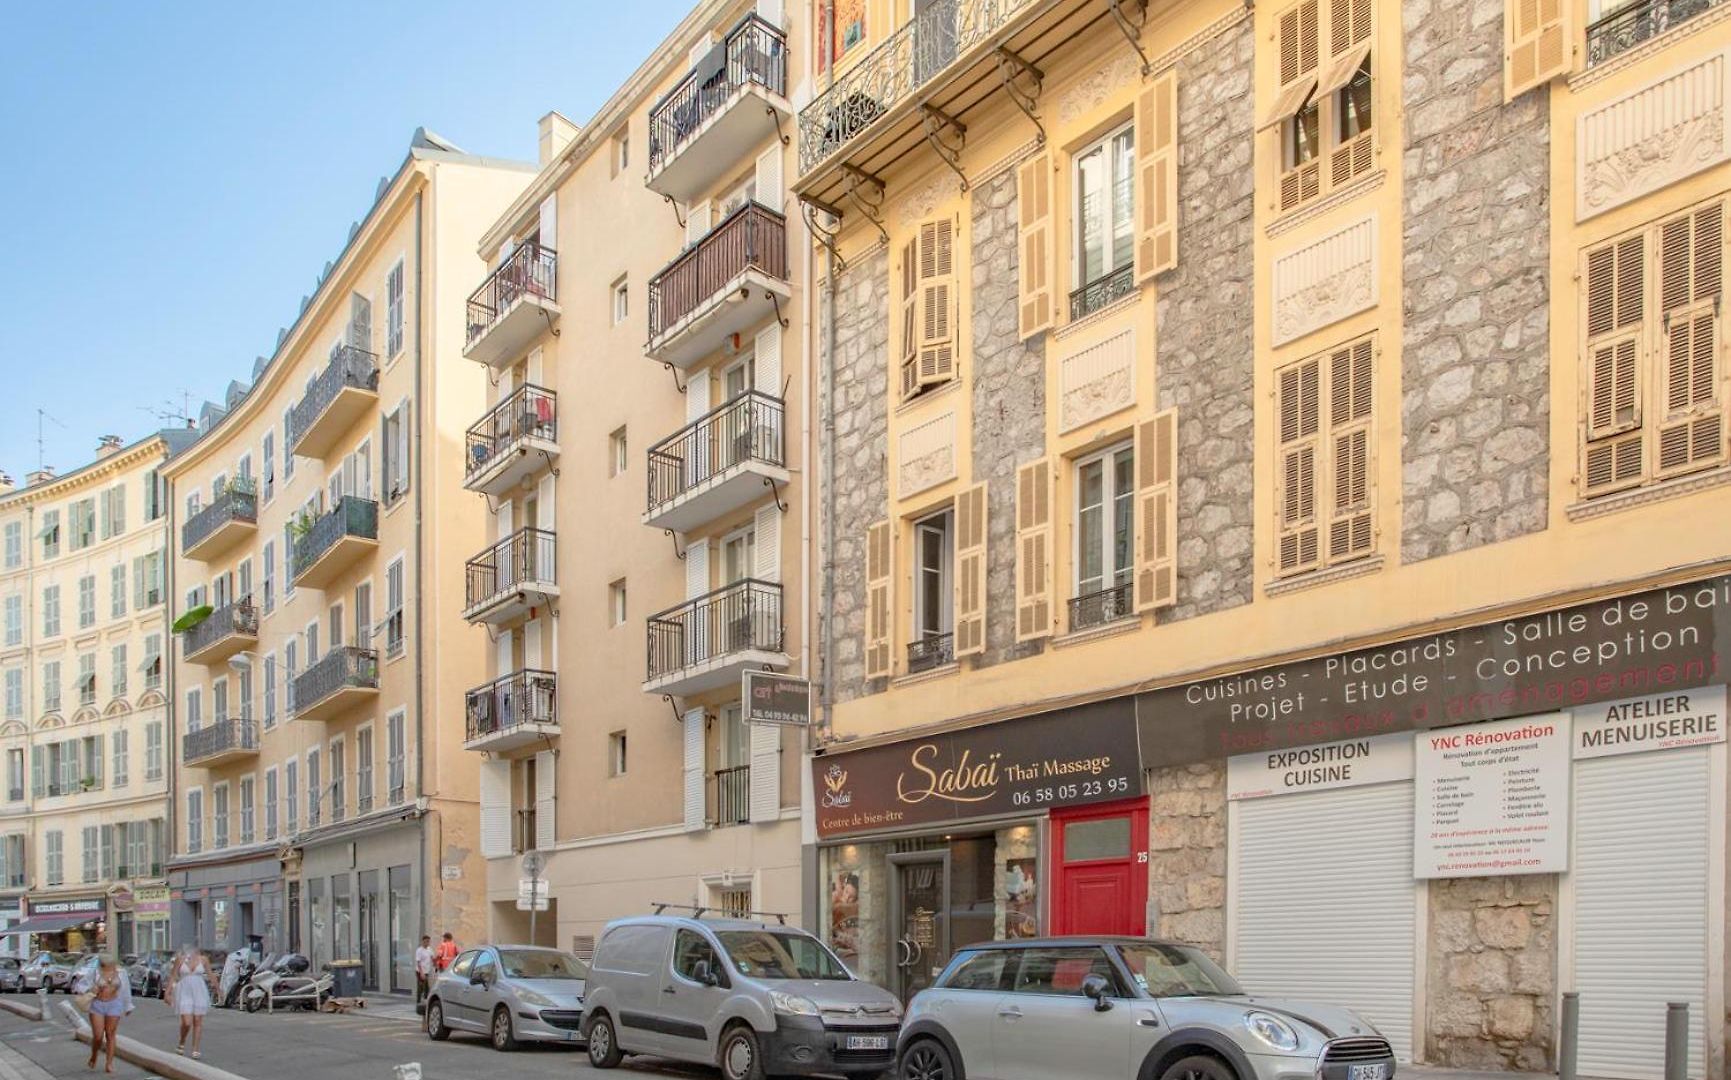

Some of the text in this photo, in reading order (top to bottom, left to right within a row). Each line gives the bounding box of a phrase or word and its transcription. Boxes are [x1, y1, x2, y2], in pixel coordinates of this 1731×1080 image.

[1186, 671, 1288, 704] Cuisines
[1326, 637, 1455, 679] Placards
[1503, 612, 1587, 646] Salle
[1602, 600, 1649, 627] de
[1231, 692, 1304, 723] Projet
[1345, 674, 1428, 703] Etude
[1476, 626, 1699, 681] Conception
[1606, 695, 1690, 723] ATELIER
[1431, 726, 1554, 750] YNC Rénovation
[1582, 714, 1718, 748] MENUISERIE
[1268, 741, 1370, 769] EXPOSITION
[897, 744, 1110, 803] Sabaï Thaï Massage
[1284, 765, 1351, 787] CUISINE
[1013, 777, 1128, 806] 06 58 05 23 95
[822, 809, 904, 830] Centre de bien-être
